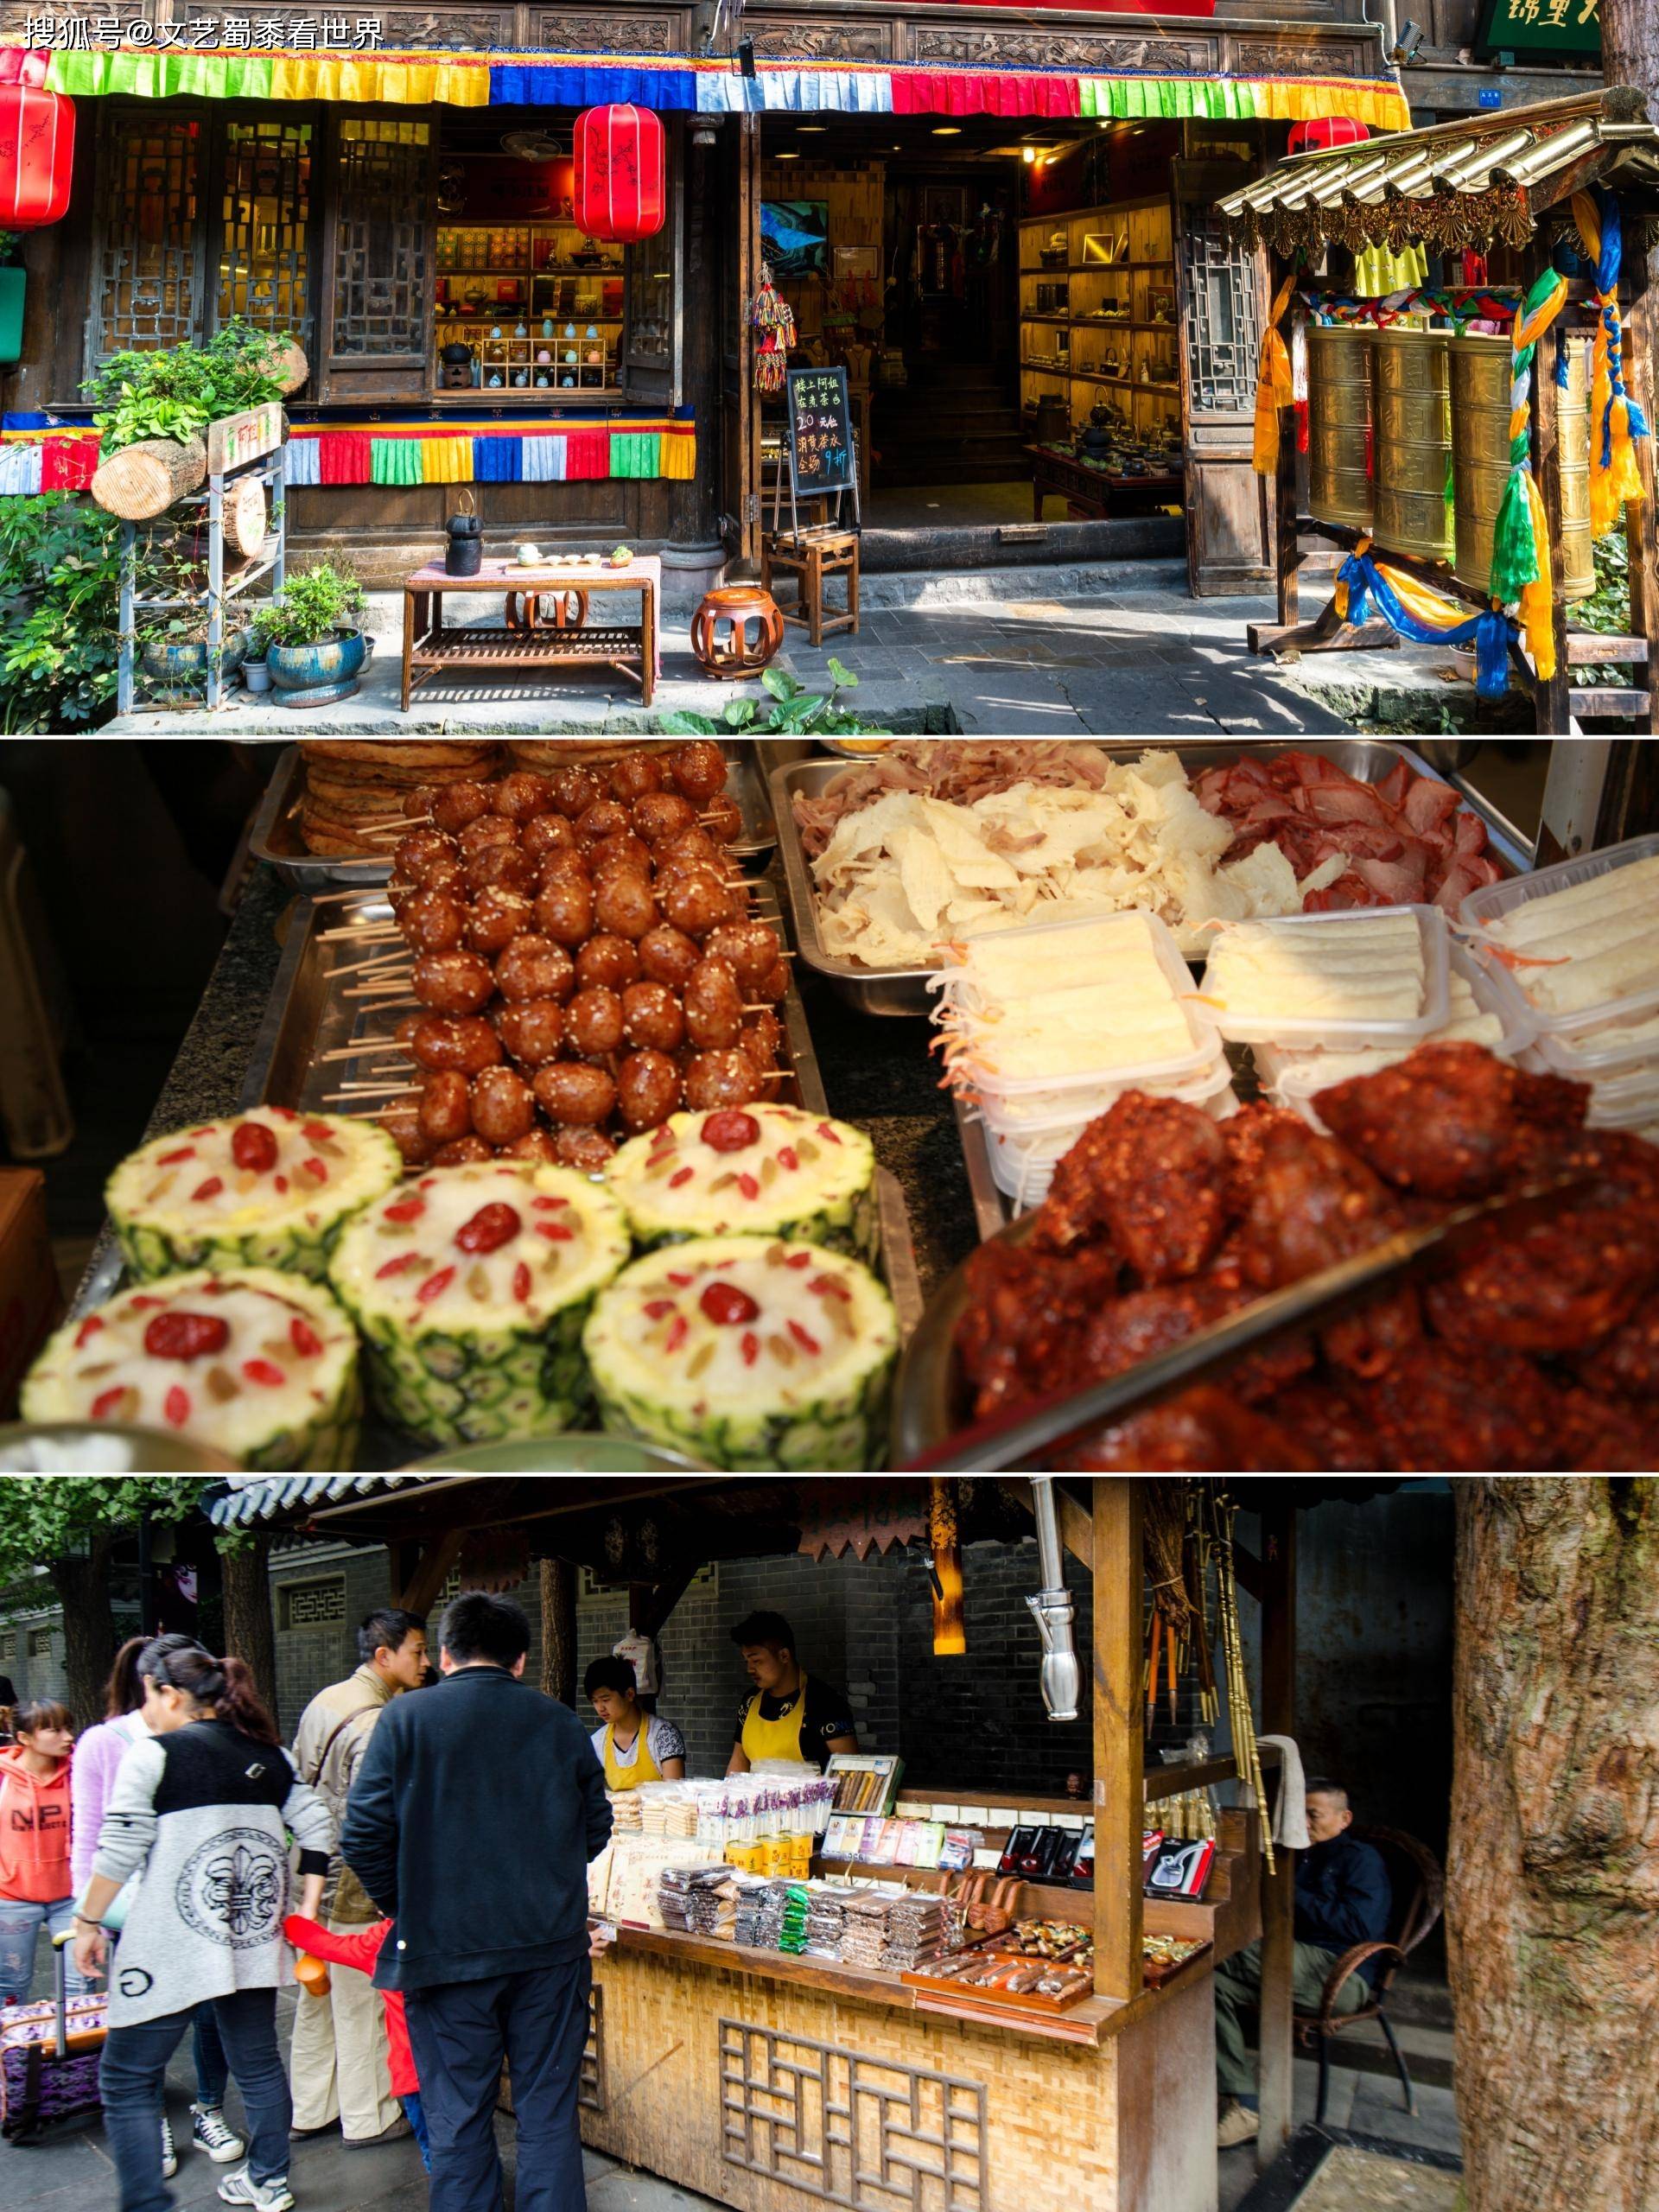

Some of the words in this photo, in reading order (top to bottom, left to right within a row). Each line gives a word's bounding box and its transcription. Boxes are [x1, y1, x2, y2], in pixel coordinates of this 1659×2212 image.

[795, 377, 839, 392] 楼上阿姐
[797, 415, 814, 431] 20
